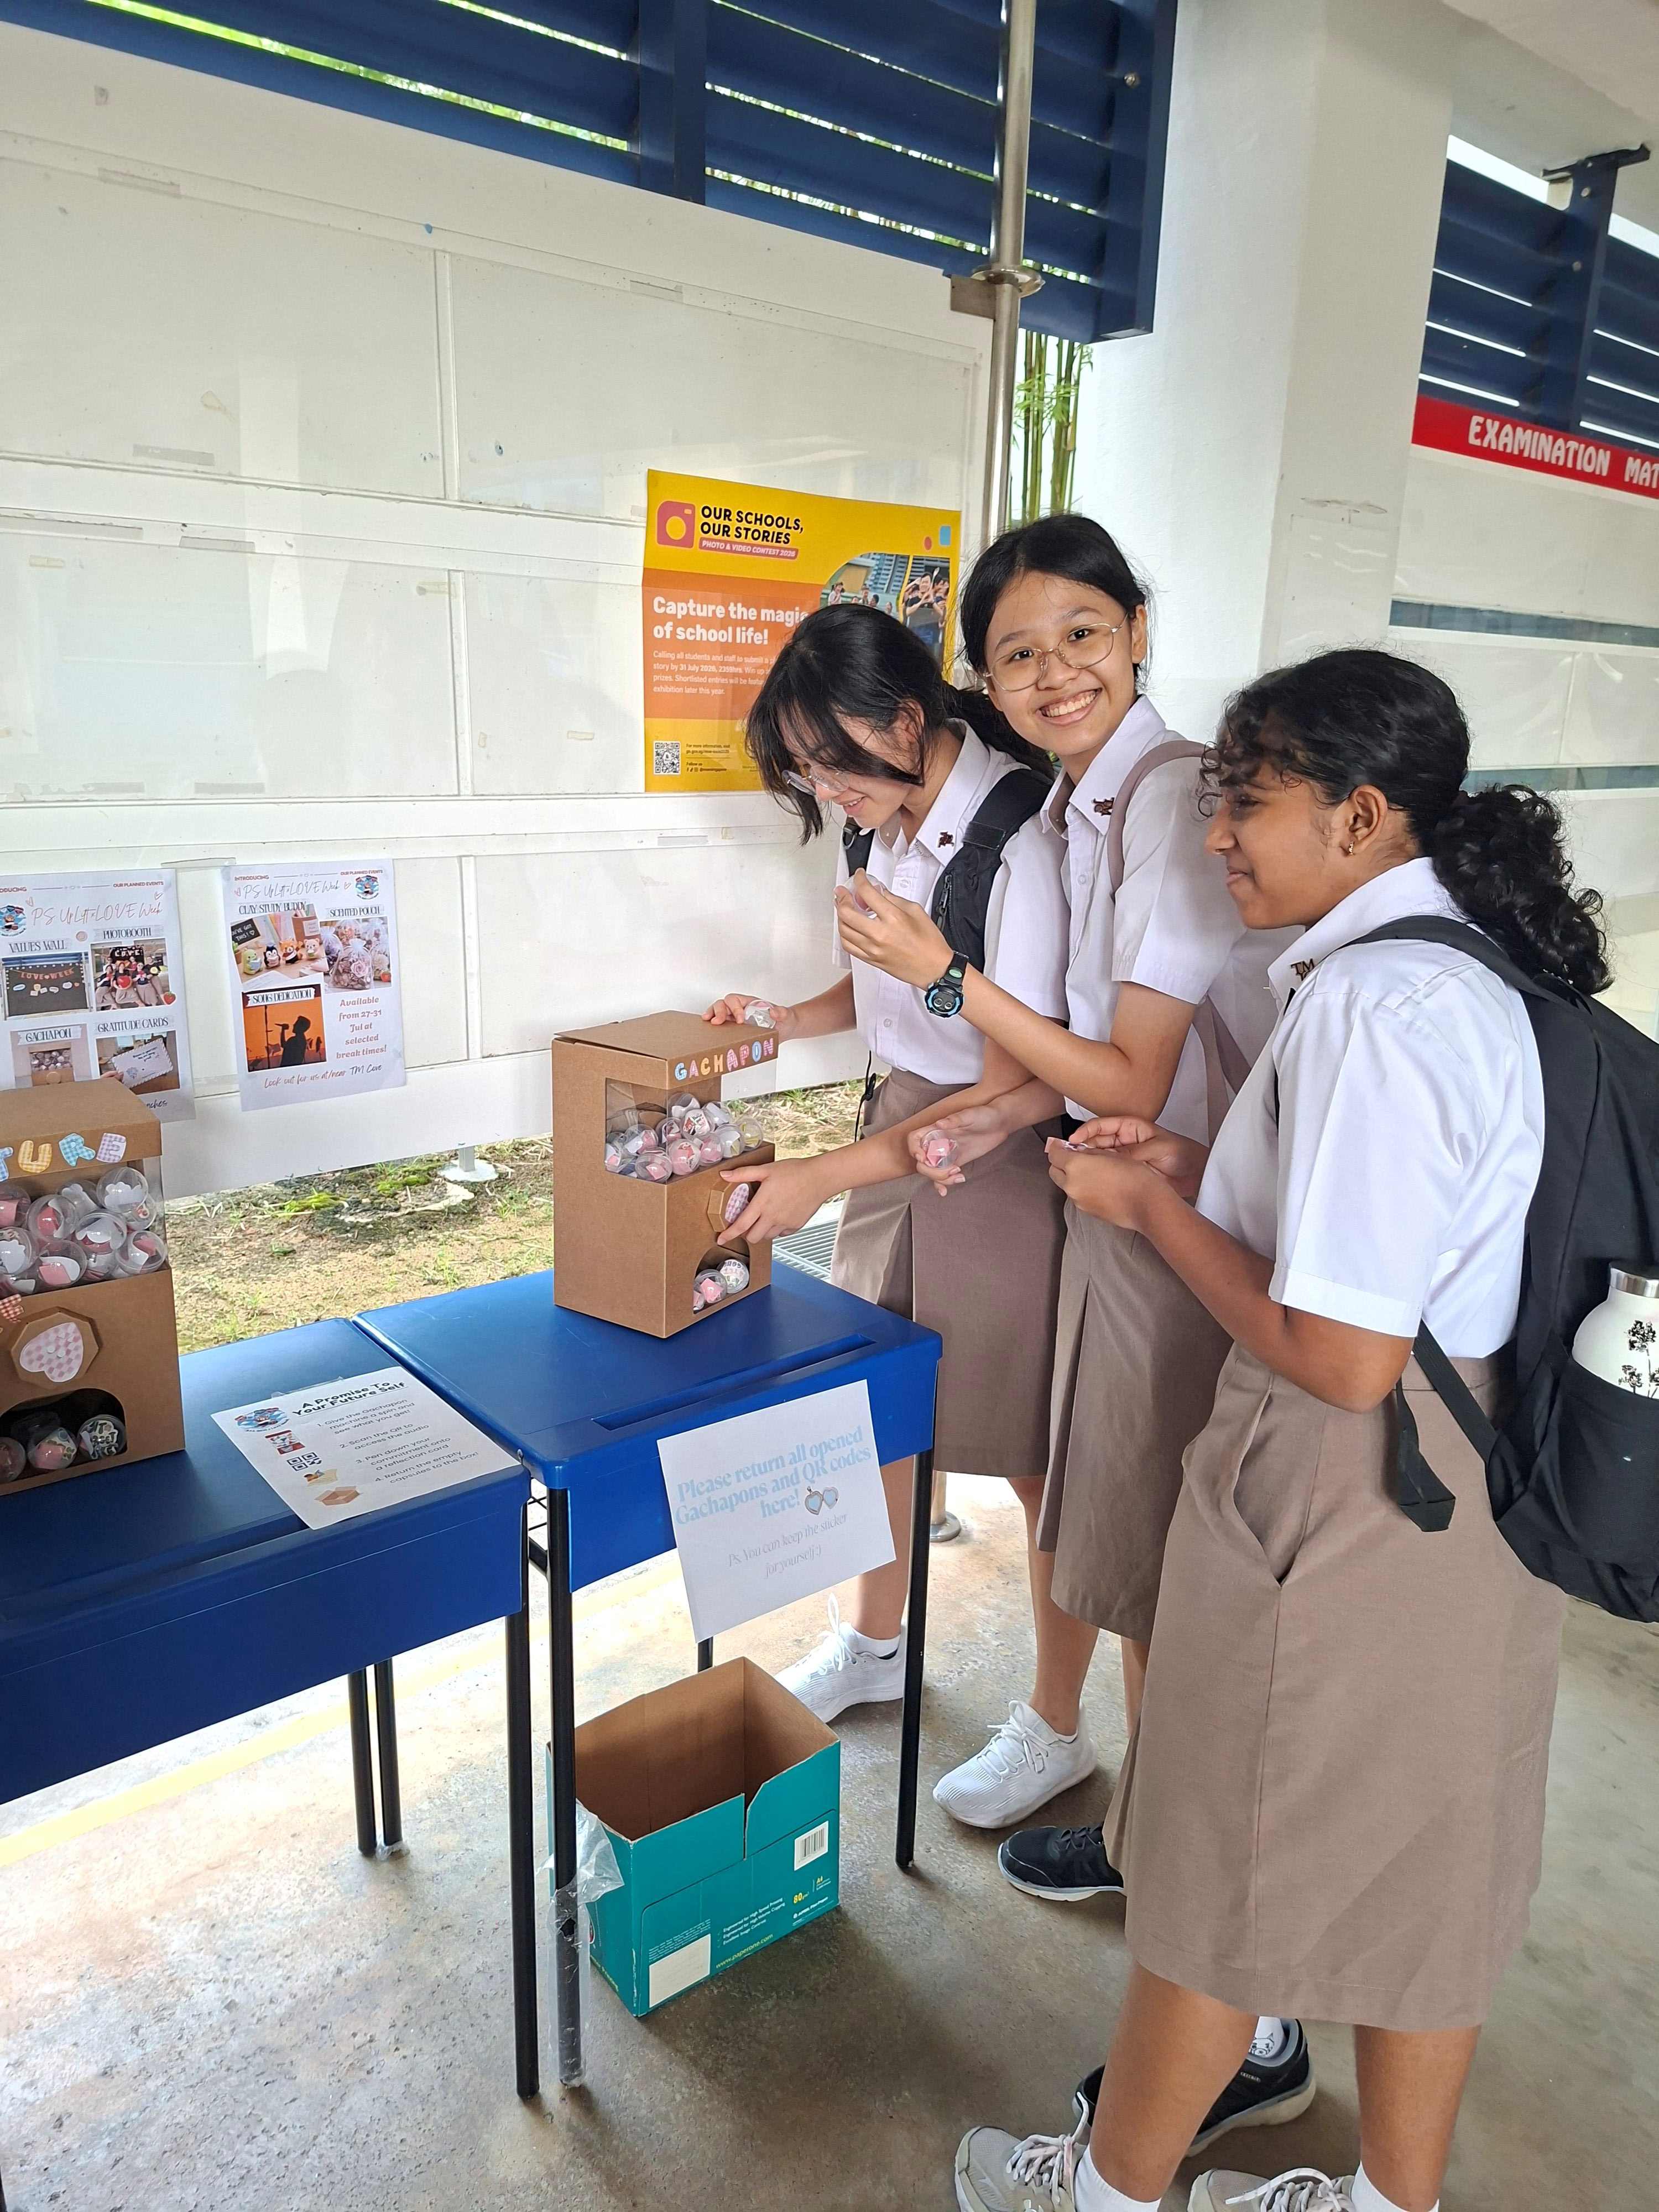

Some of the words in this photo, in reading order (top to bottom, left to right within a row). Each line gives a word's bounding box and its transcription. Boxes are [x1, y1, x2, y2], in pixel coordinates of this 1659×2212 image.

[1468, 415, 1611, 477] EXAMINATION
[701, 505, 732, 521] OUR
[735, 510, 804, 534] SCHOOLS,
[700, 521, 731, 538] OUR
[734, 526, 791, 544] STORIES
[702, 540, 724, 550] PHOTO
[732, 544, 752, 553] VIDEO
[752, 546, 780, 556] CONTEST
[653, 596, 726, 619] Capture
[728, 602, 757, 620] the
[653, 621, 674, 639] of
[676, 624, 733, 643] school
[736, 626, 769, 645] life!
[653, 651, 676, 660] Calling
[685, 653, 711, 661] students
[675, 674, 707, 683] Shortlisted
[243, 885, 261, 899] PS
[290, 881, 322, 895] LOVE
[32, 907, 56, 926] PS
[95, 902, 138, 921] LOVE
[238, 904, 258, 914] CLAY
[259, 902, 282, 912] STUDY
[284, 901, 307, 911] BUDDY
[330, 907, 358, 917] SCENTED
[359, 906, 380, 915] POUCH
[103, 927, 152, 939] PHOTOBOOTH
[9, 941, 42, 953] VALUES
[43, 940, 67, 951] WALL
[252, 992, 273, 1004] SONG
[274, 989, 311, 1002] DEDICATION
[340, 997, 379, 1007] Available
[338, 1012, 359, 1022] from
[361, 1009, 382, 1018] 27-31
[25, 1027, 72, 1042] GACHAPON
[97, 1021, 140, 1033] GRATITUDE
[142, 1018, 169, 1029] CARDS
[349, 1024, 363, 1033] Jul
[345, 1034, 379, 1046] selected
[336, 1050, 361, 1060] break
[362, 1044, 387, 1056] times!
[674, 1037, 774, 1081] GACHAPON
[264, 1077, 281, 1089] Look
[284, 1076, 295, 1085] out
[296, 1074, 307, 1085] for
[292, 1404, 328, 1416] Your
[330, 1390, 377, 1406] Future
[378, 1382, 406, 1392] Self
[314, 1387, 369, 1405] Promise
[325, 1417, 345, 1426] Give
[362, 1399, 408, 1415] Gachapon
[330, 1415, 369, 1430] machine
[378, 1407, 397, 1417] spin
[398, 1402, 415, 1410] and
[351, 1420, 375, 1428] what
[375, 1415, 393, 1423] you
[349, 1435, 373, 1446] Scan
[373, 1429, 389, 1437] the
[354, 1438, 387, 1451] access
[404, 1424, 430, 1435] audio
[365, 1453, 383, 1462] Pen
[384, 1443, 410, 1455] down
[410, 1437, 430, 1447] your
[371, 1443, 430, 1466] commitment
[430, 1437, 451, 1446] onto
[384, 1452, 427, 1469] reflection
[384, 1465, 415, 1480] Return
[415, 1459, 432, 1469] the
[432, 1449, 462, 1463] empty
[677, 1472, 732, 1503] Please
[734, 1455, 785, 1483] return
[787, 1443, 807, 1465] all
[810, 1424, 863, 1460] opened
[389, 1467, 432, 1484] capsules
[443, 1457, 458, 1465] the
[675, 1482, 768, 1525] Gachapons
[771, 1467, 801, 1493] and
[802, 1459, 828, 1484] QR
[830, 1447, 871, 1472] codes
[760, 1488, 800, 1519] here!
[743, 1547, 761, 1561] You
[762, 1540, 780, 1553] can
[781, 1531, 804, 1546] keep
[805, 1524, 819, 1538] the
[820, 1513, 847, 1532] sticker
[793, 1892, 803, 1903] 80
[716, 1933, 773, 1969] www.paperone.com
